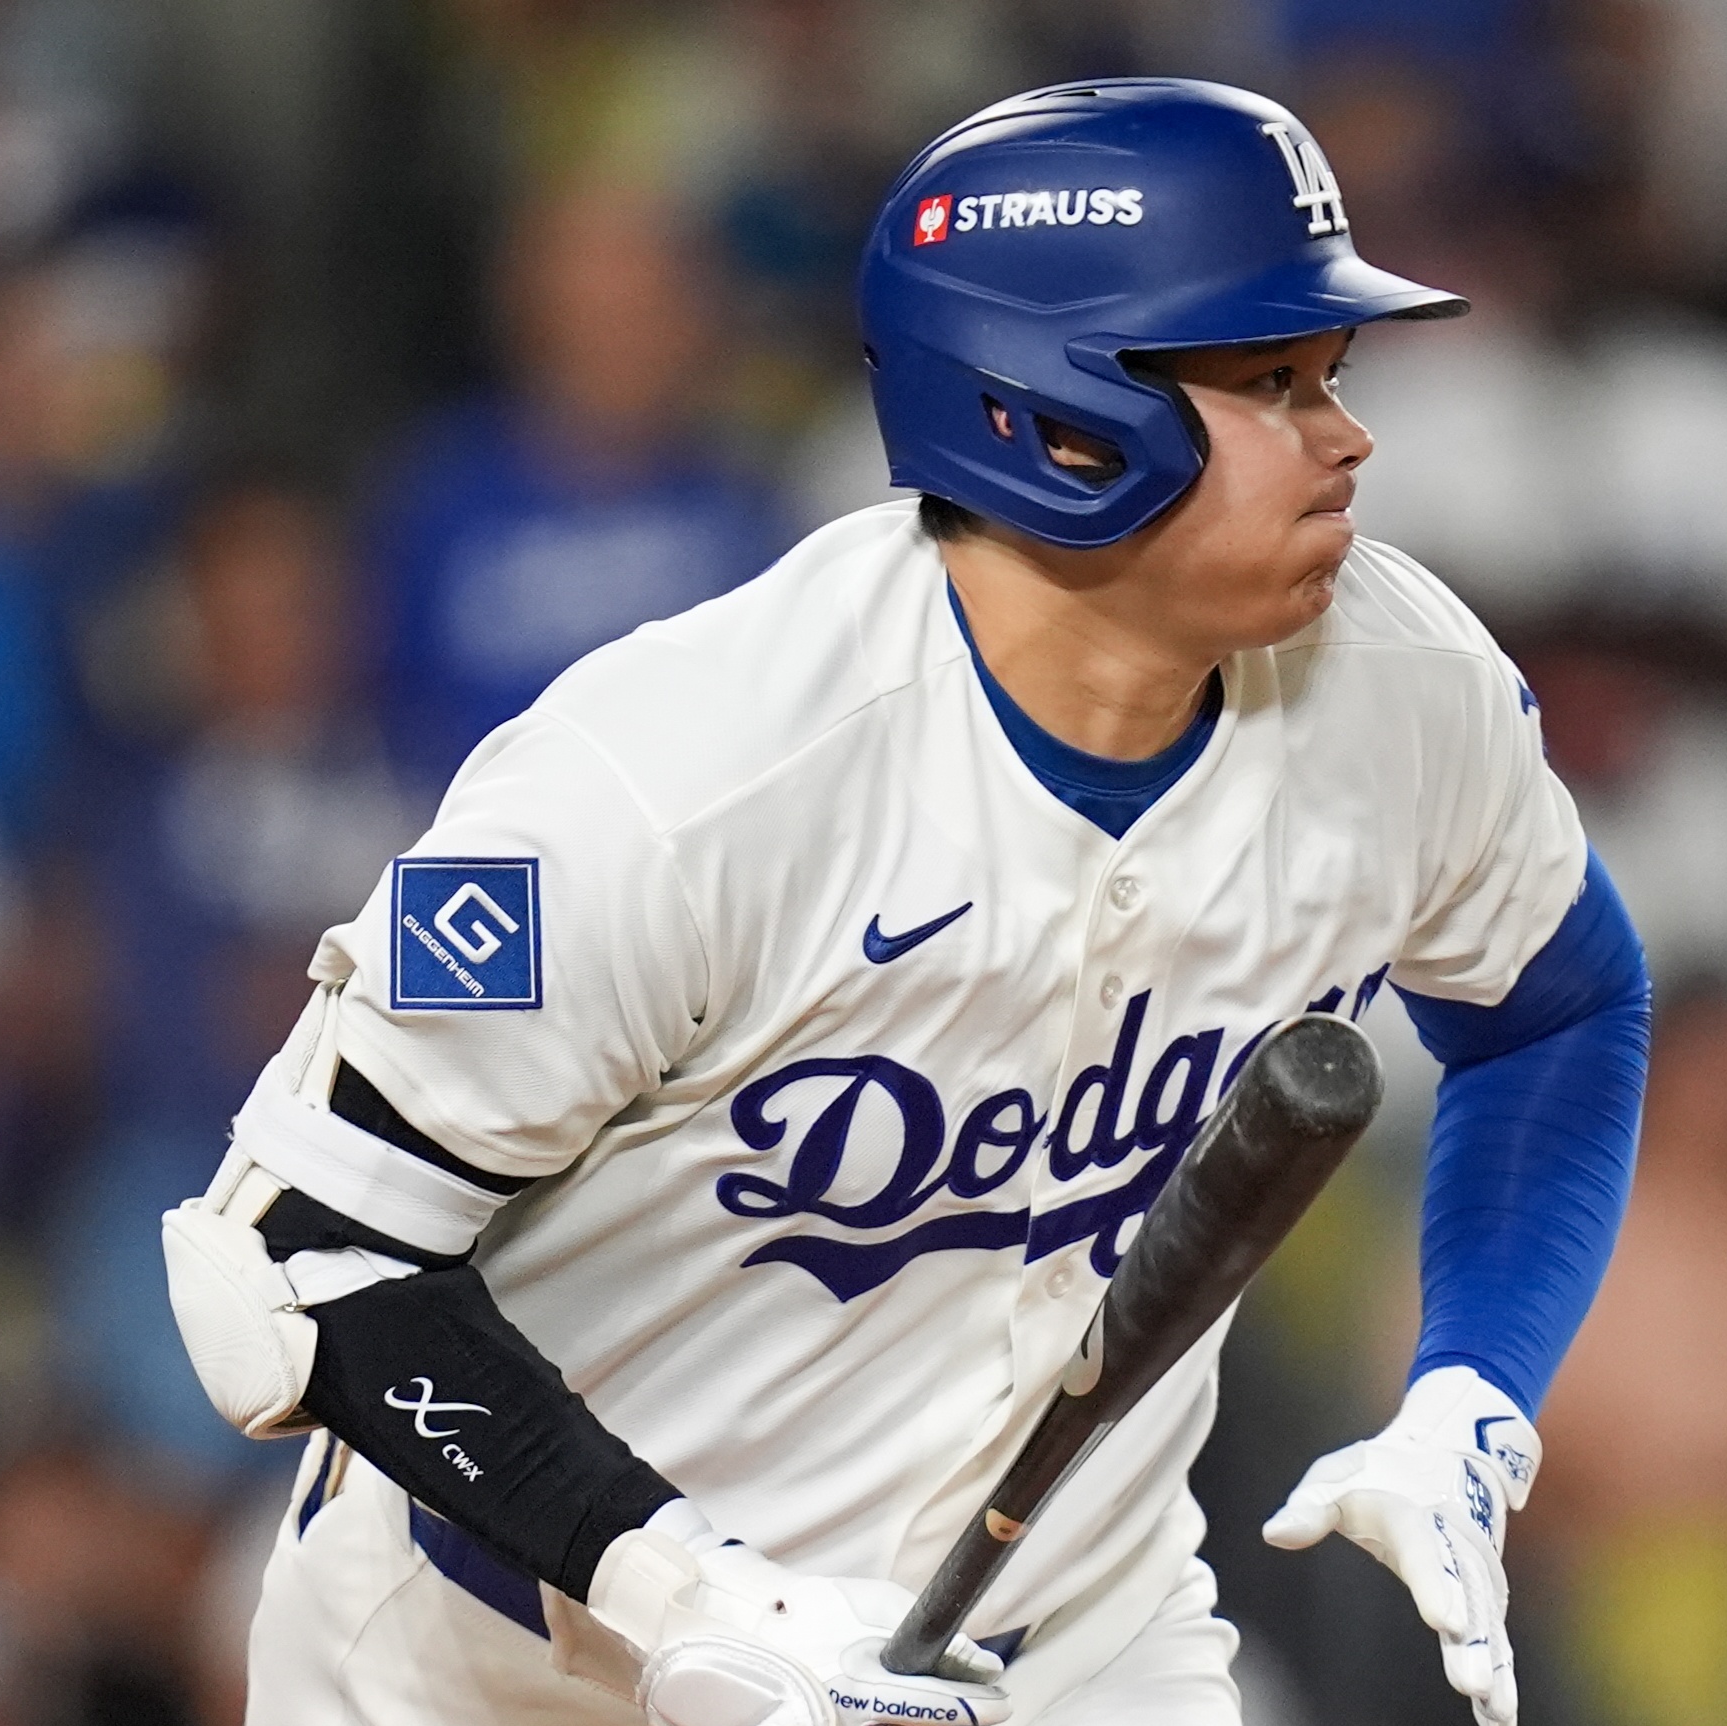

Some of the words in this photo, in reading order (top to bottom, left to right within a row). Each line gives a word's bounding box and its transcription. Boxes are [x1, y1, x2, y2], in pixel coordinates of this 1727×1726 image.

[954, 188, 1144, 233] STRAUSS
[402, 913, 485, 998] GUGGENHEIM
[716, 962, 1391, 1280] Dodg
[441, 1442, 484, 1482] CW-X
[829, 1688, 869, 1710] new
[873, 1696, 958, 1721] balance
